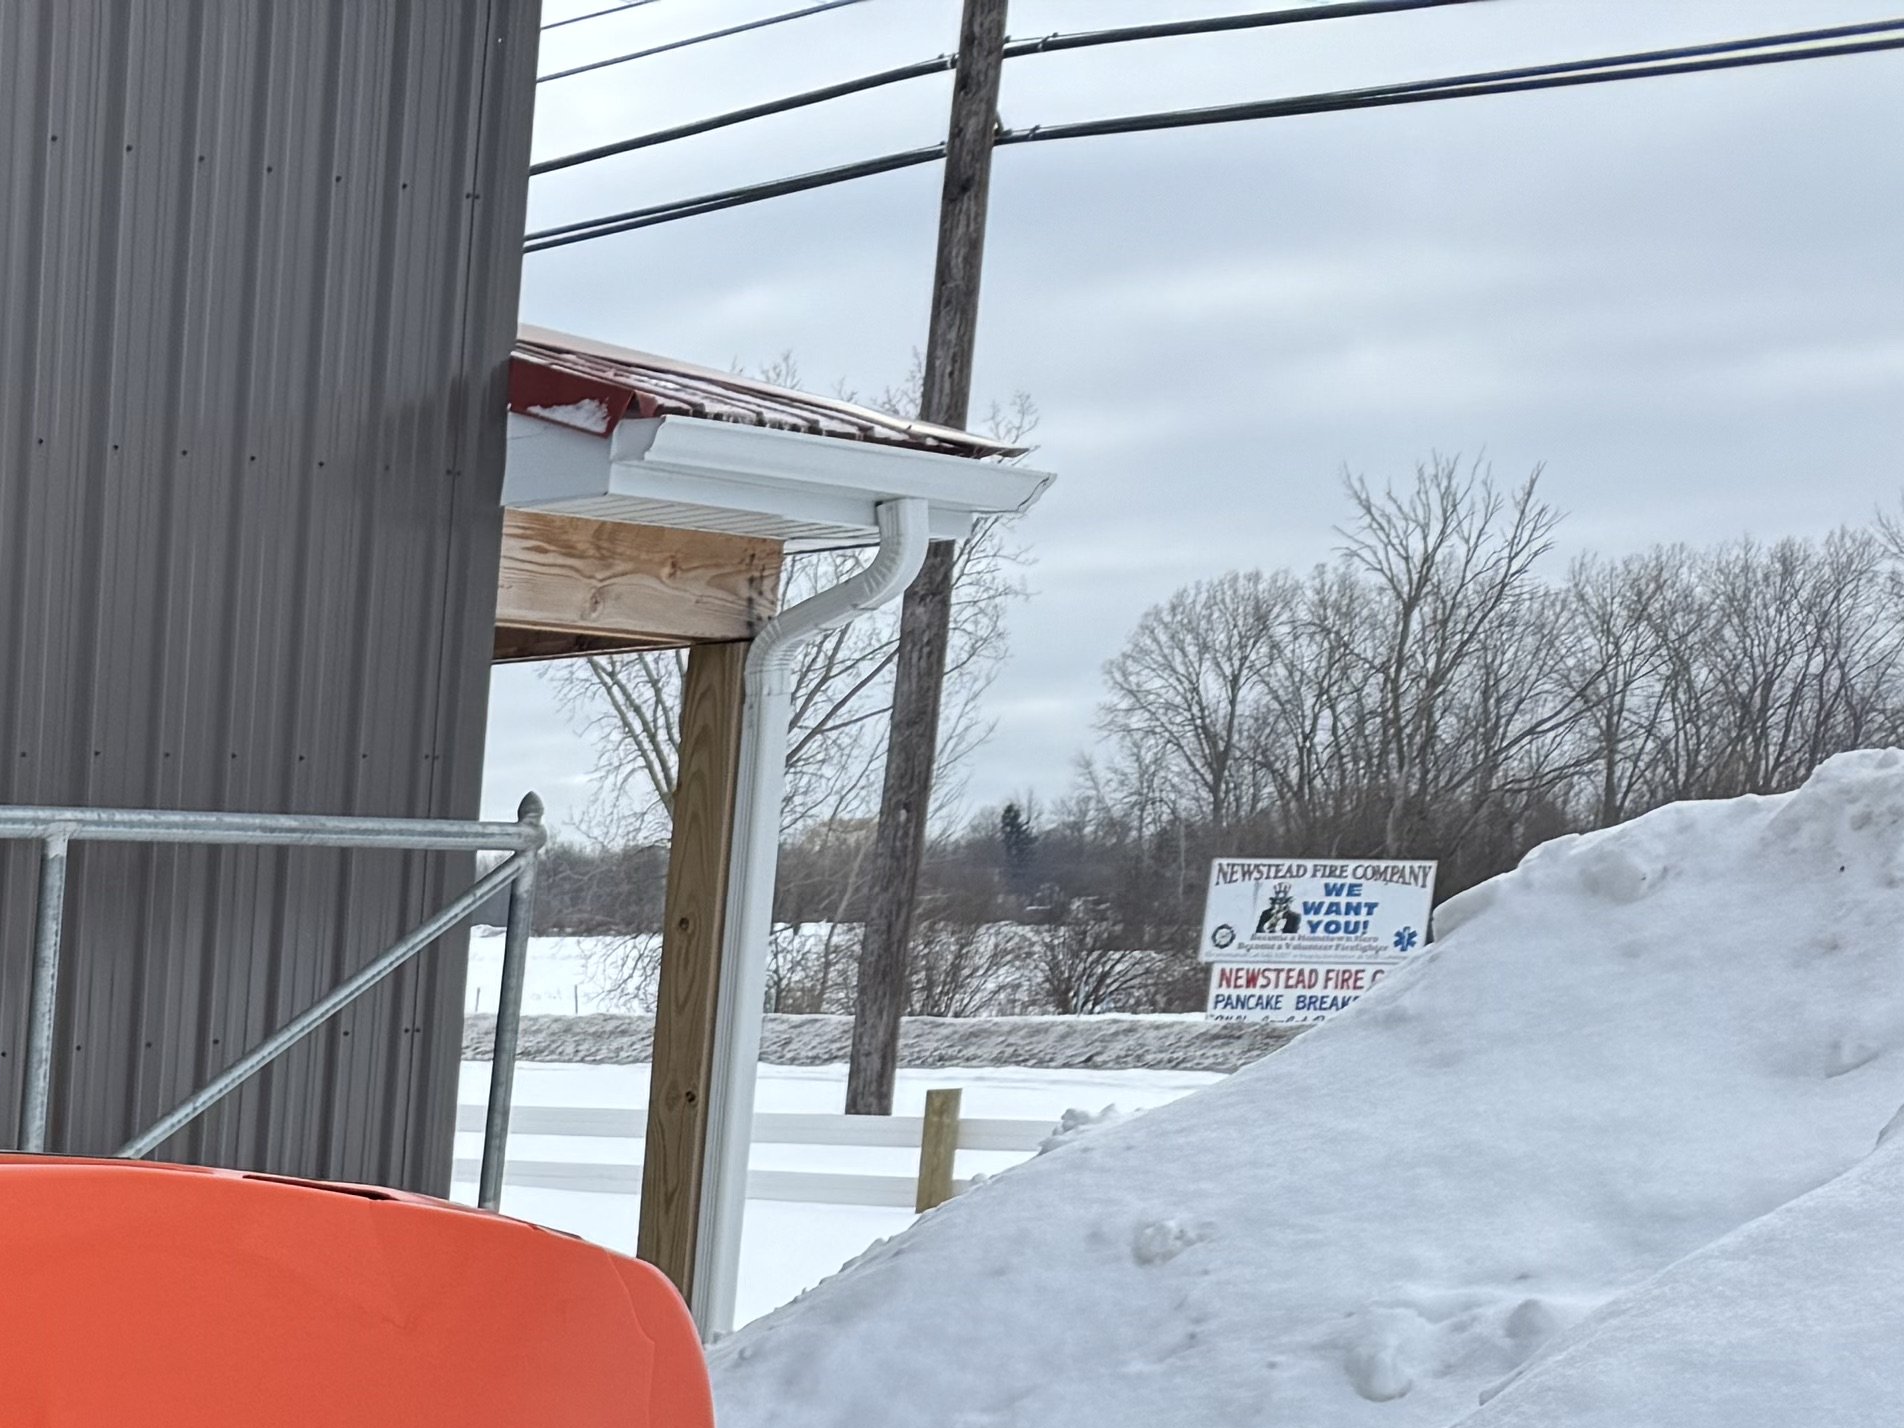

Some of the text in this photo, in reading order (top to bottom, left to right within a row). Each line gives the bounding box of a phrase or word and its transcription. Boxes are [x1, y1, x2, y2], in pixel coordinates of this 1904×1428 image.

[1215, 862, 1432, 888] NEWSTEAD FIRE COMPANY
[1323, 882, 1363, 897] WE
[1302, 901, 1379, 916] WANT
[1307, 919, 1369, 936] YOU!
[1218, 967, 1318, 989] NEWSTEAD
[1323, 968, 1365, 990] FIRE
[1213, 993, 1284, 1010] PANCAKE
